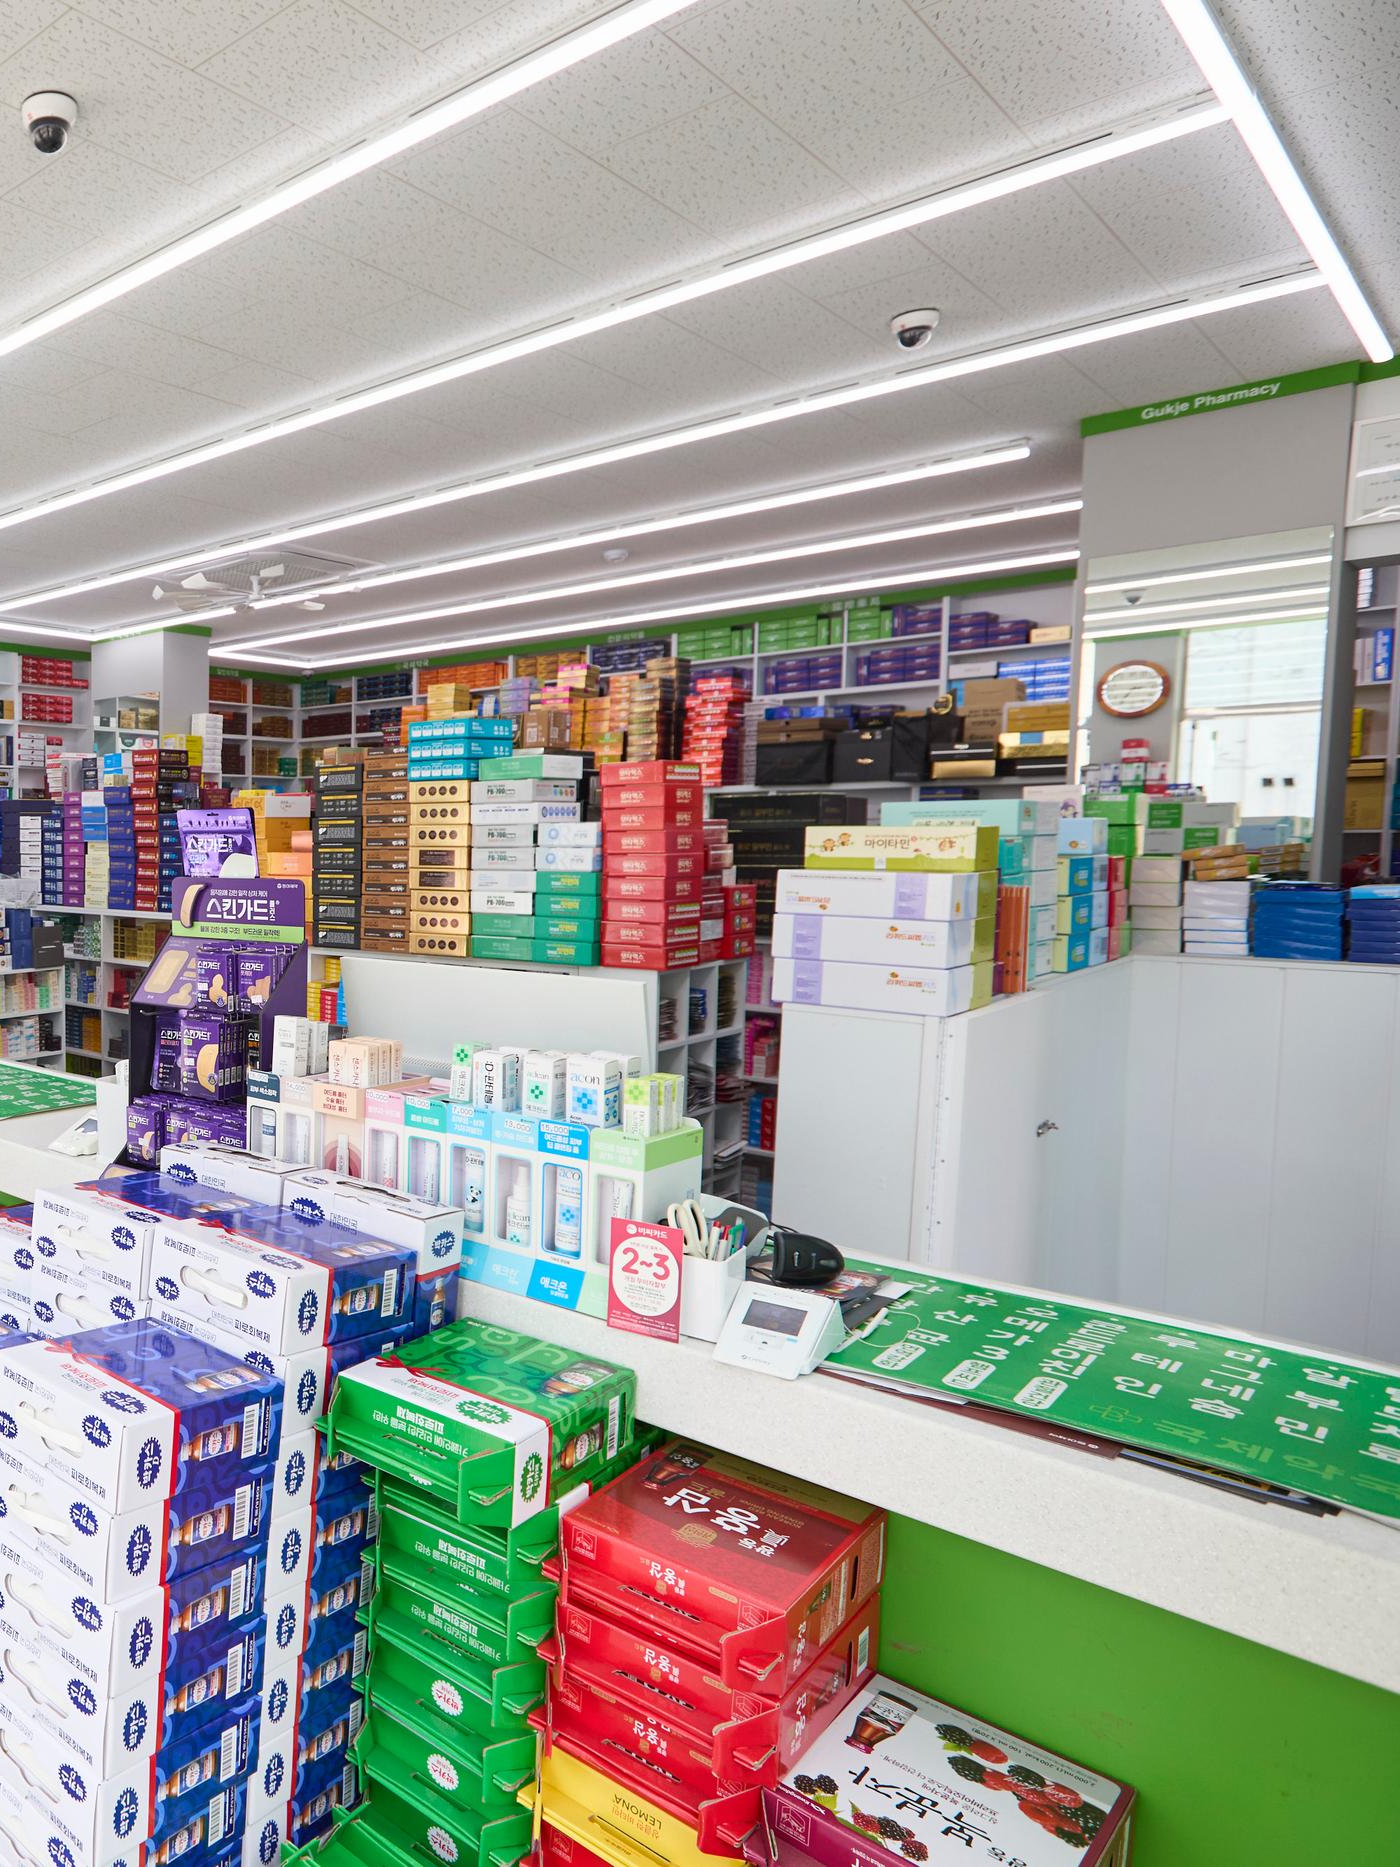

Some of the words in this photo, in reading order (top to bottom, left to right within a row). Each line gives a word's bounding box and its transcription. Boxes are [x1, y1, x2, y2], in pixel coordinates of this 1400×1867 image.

[1141, 401, 1190, 420] Gukje
[1193, 382, 1281, 409] Pharmacy
[864, 838, 911, 850] 마이타민
[206, 898, 269, 921] 스킨가드
[184, 1027, 211, 1041] 스킨가드
[292, 1203, 325, 1219] 박카스
[433, 1235, 455, 1251] 박카스
[621, 1247, 671, 1282] 2~3
[233, 1317, 271, 1344] 피로회복제
[1113, 1333, 1200, 1400] 루테인
[1187, 1348, 1278, 1420] 마그네슘
[396, 1404, 445, 1435] 피로회복제
[1274, 1365, 1359, 1445] 알부민
[143, 1442, 154, 1484] 박카스
[70, 1467, 107, 1500] 피로회복제
[662, 1487, 761, 1537] 홍삼
[133, 1528, 144, 1572] 박카스
[438, 1538, 487, 1570] 피로회복제
[59, 1551, 95, 1587] 피로회복제
[649, 1561, 677, 1586] 홍삼
[613, 1792, 663, 1828] LEMONA
